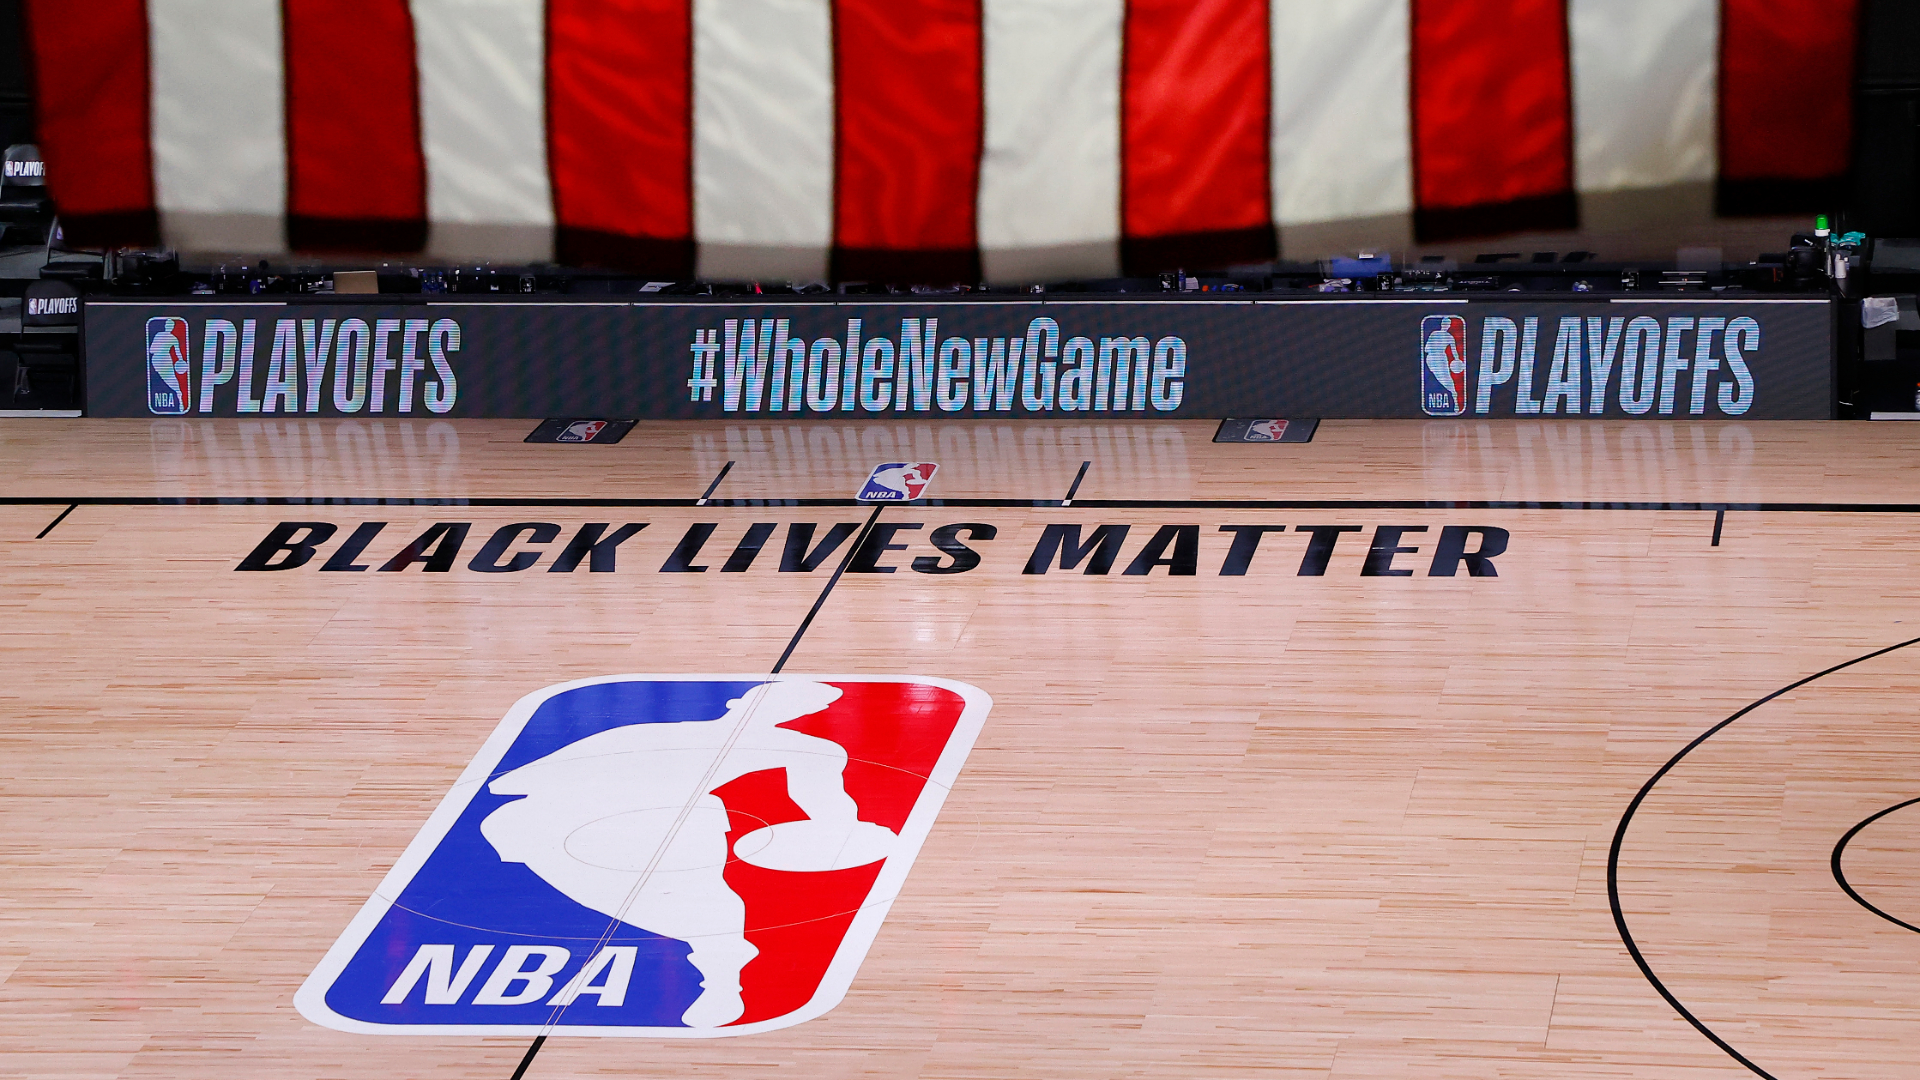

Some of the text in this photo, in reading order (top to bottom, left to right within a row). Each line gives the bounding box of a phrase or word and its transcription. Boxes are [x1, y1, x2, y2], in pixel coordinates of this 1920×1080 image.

[13, 161, 46, 177] PLAYOF
[37, 297, 78, 315] PLAYOFFS
[199, 318, 461, 413] PLAYOFFS
[687, 316, 1188, 412] #WholeNewGame
[1475, 316, 1760, 415] PLAYOFFS
[154, 392, 175, 407] NBA
[1428, 393, 1450, 409] NBA
[865, 491, 897, 499] NBA
[233, 522, 1510, 577] BLACK LIVES MATTER
[379, 944, 639, 1007] NBA
